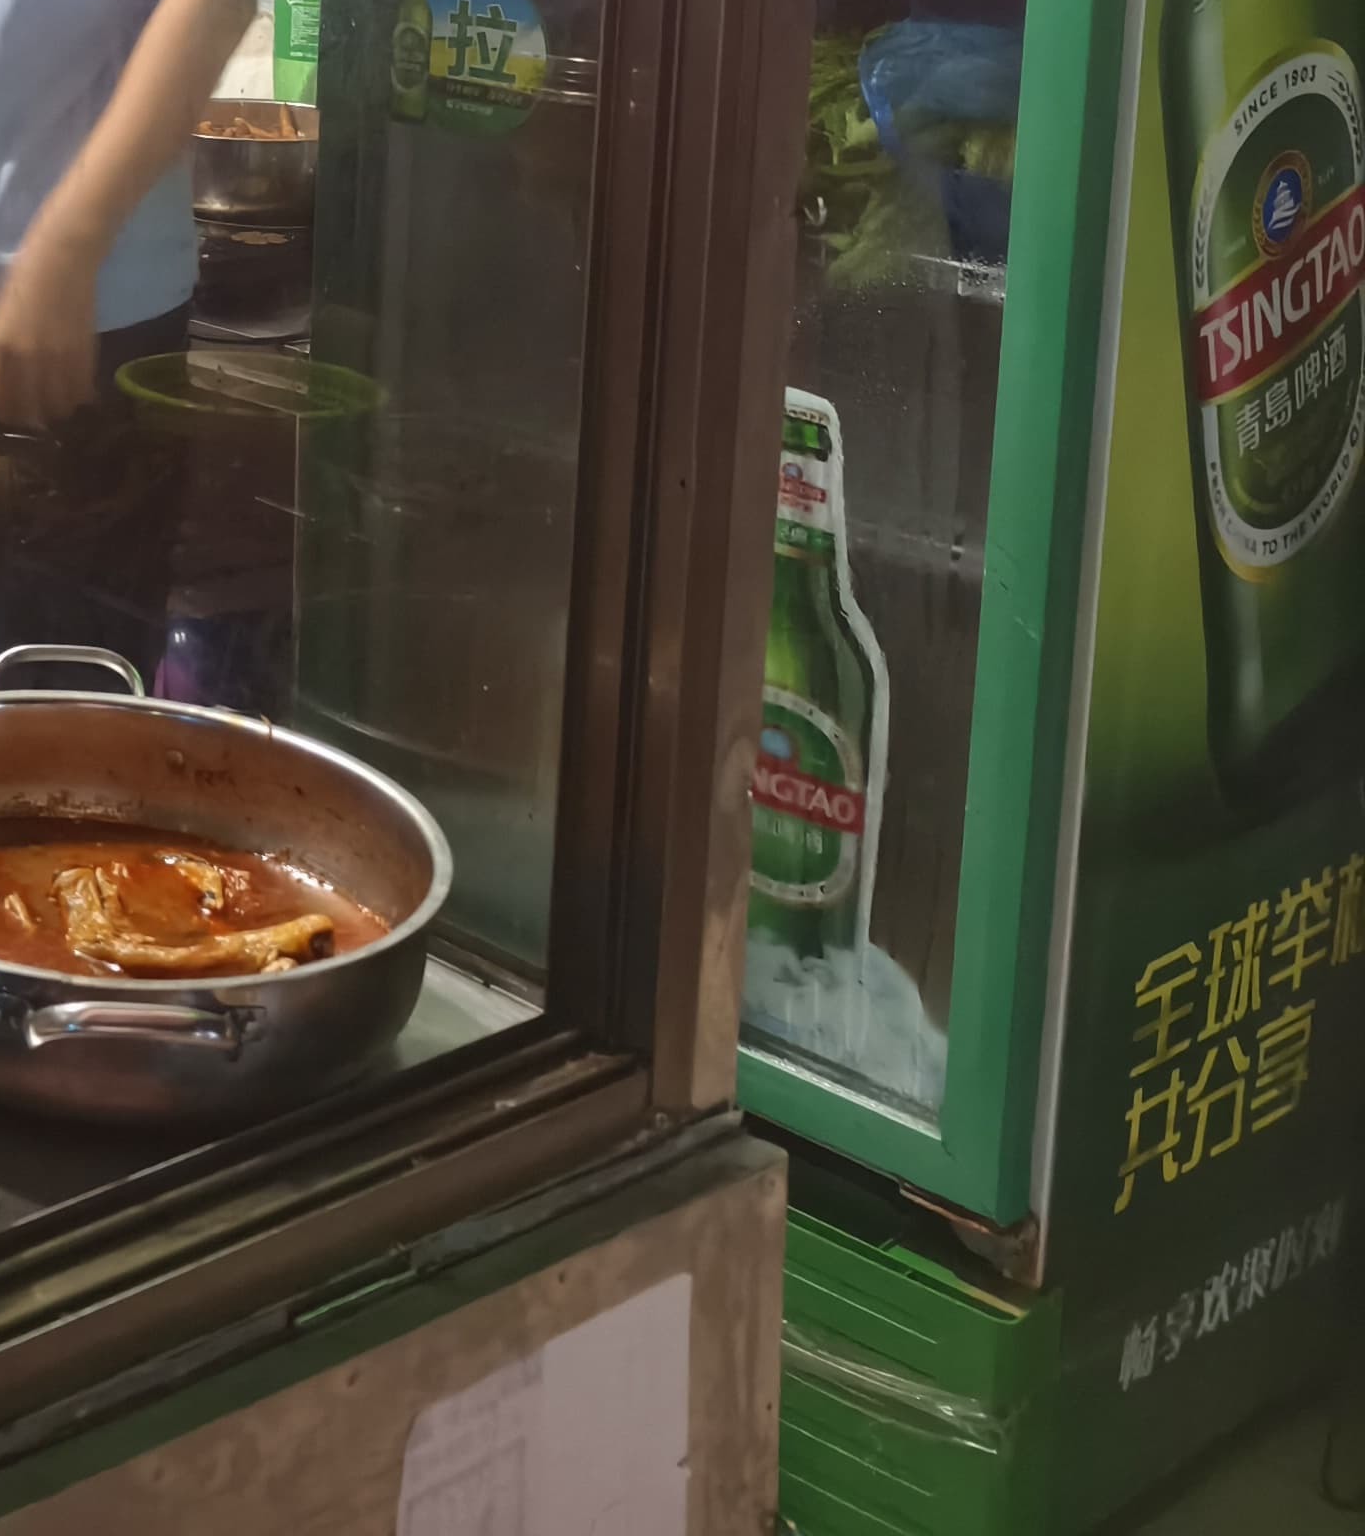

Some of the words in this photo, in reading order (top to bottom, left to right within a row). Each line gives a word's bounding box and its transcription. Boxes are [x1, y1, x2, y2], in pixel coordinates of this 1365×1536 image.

[1233, 80, 1279, 138] SINCE
[1285, 64, 1318, 90] 1903
[1200, 203, 1365, 383] TSINGTAO
[1234, 323, 1348, 459] 青島啤酒
[1261, 538, 1278, 556] TO
[1282, 520, 1307, 550] THE
[1114, 998, 1317, 1215] 共分享
